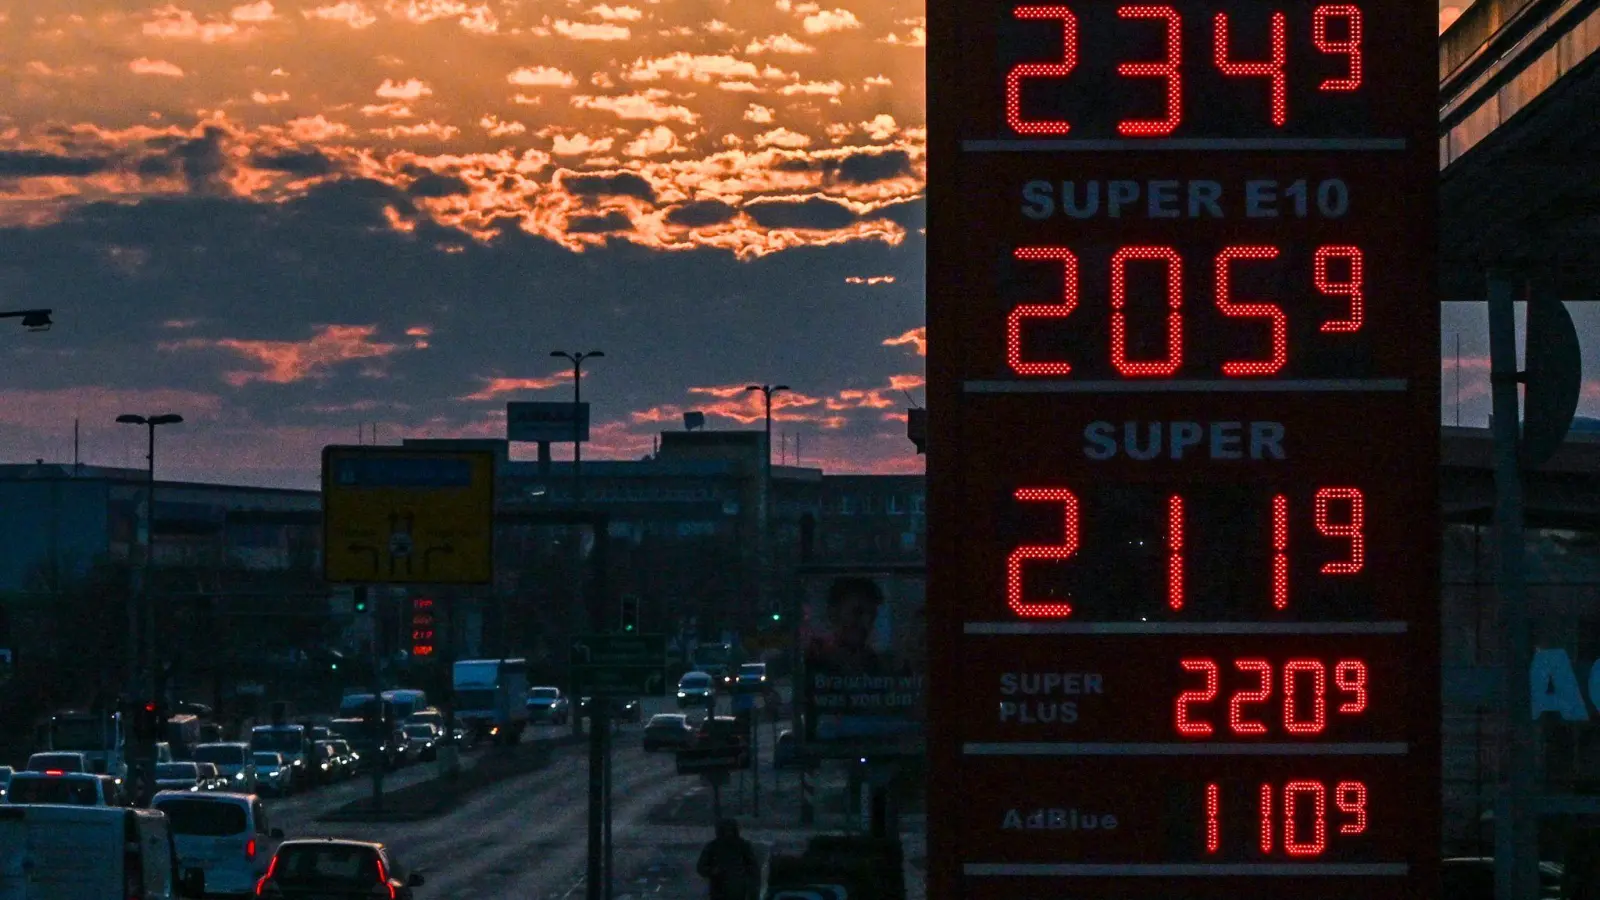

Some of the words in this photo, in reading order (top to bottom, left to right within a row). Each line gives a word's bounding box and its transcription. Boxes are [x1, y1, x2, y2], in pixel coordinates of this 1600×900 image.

[1020, 179, 1225, 220] SUPER
[1245, 178, 1351, 219] E10
[1082, 420, 1287, 461] SUPER
[814, 672, 895, 690] Brauchen
[999, 672, 1104, 695] SUPER
[813, 693, 846, 707] was
[850, 693, 881, 707] von
[999, 700, 1079, 723] PLUS
[1002, 808, 1120, 831] AdBlue
